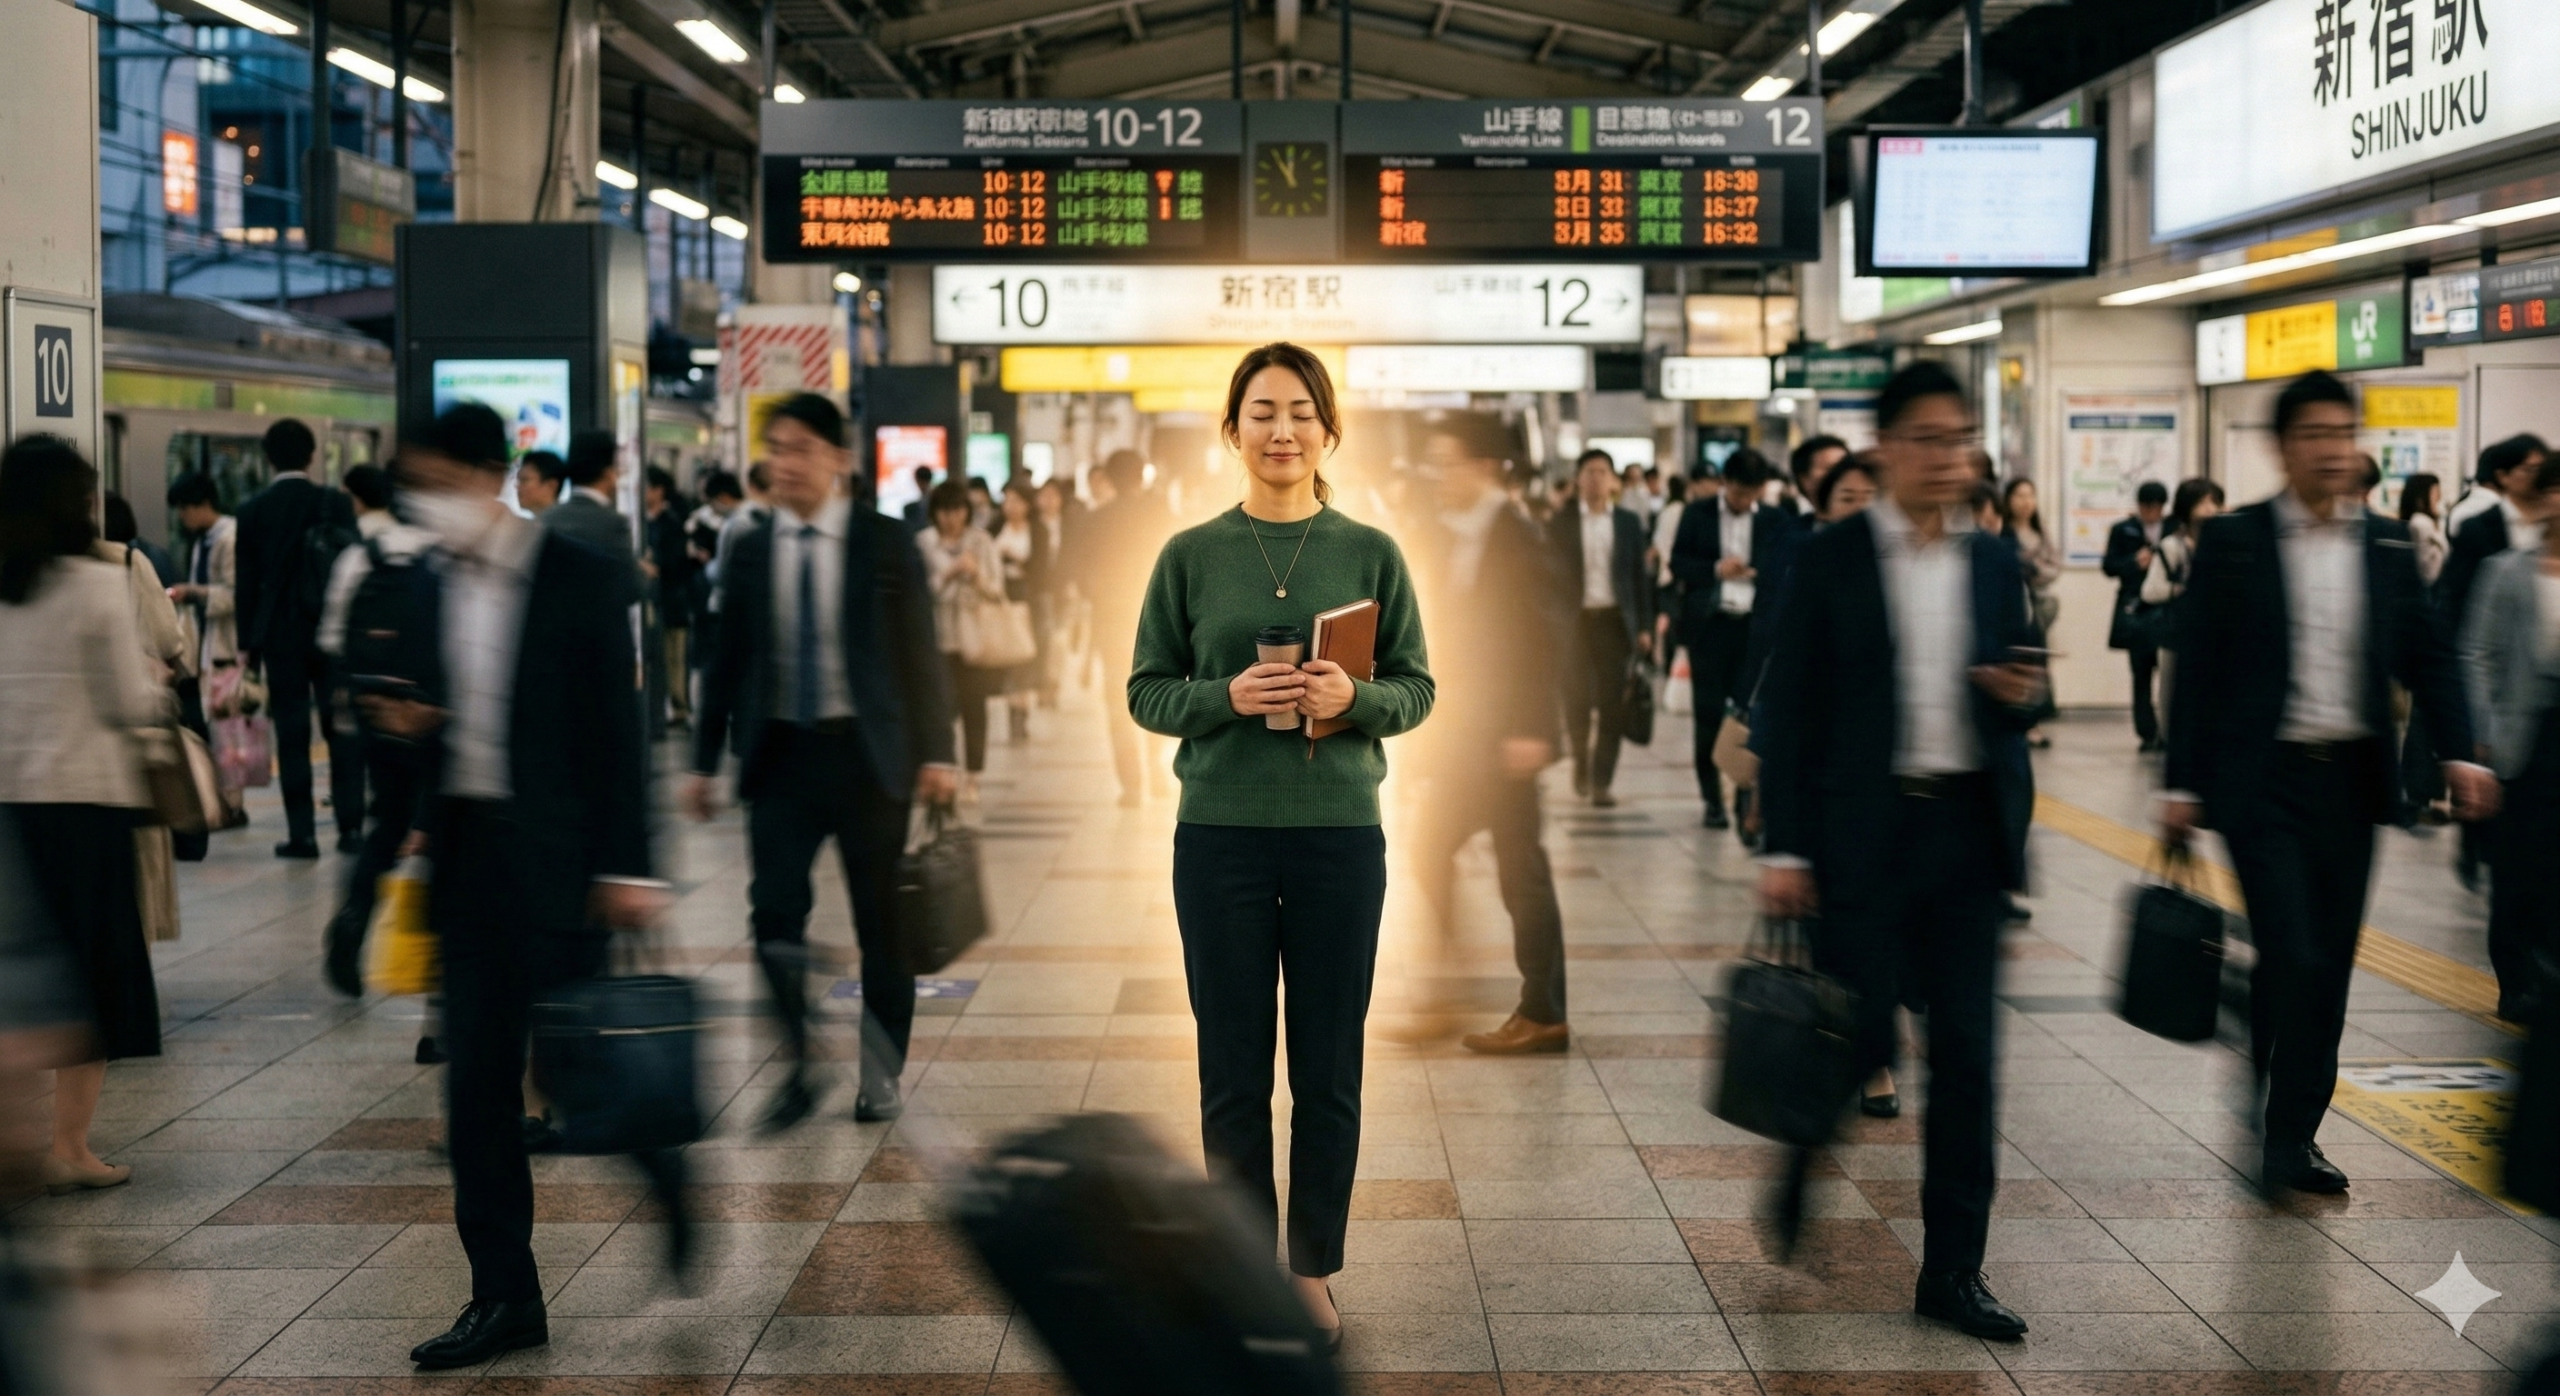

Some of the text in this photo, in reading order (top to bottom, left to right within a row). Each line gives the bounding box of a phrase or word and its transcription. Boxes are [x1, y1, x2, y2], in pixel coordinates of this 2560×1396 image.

[1093, 107, 1203, 147] 10-12
[1483, 106, 1563, 132] 山手線
[1765, 106, 1812, 147] 12
[2351, 70, 2487, 159] SHINJUKU
[1459, 132, 1563, 147] Yamanote Line
[1596, 132, 1726, 146] Destination boards
[1703, 196, 1759, 219] 16:37
[1703, 221, 1759, 245] 16:32
[989, 279, 1050, 328] 10
[1220, 274, 1343, 308] 新宿駅
[1533, 278, 1590, 326] 12
[2350, 300, 2378, 342] JR
[38, 337, 70, 406] 10
